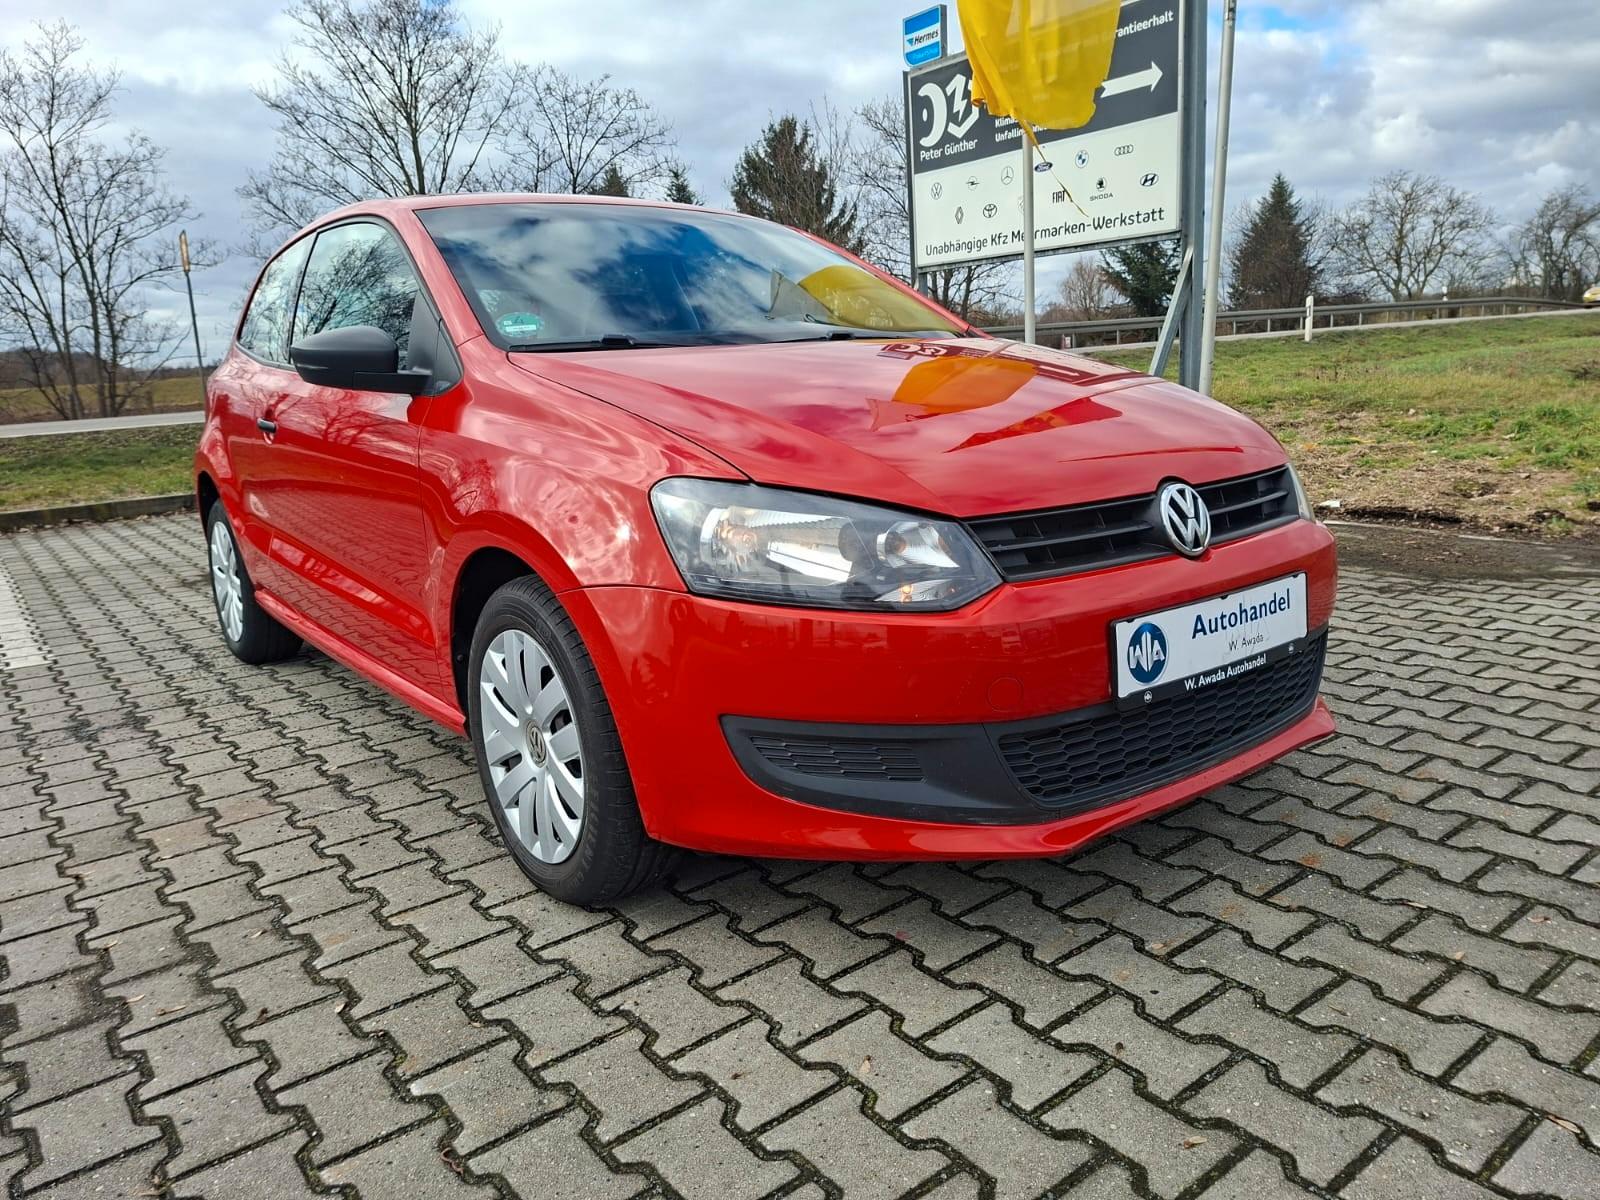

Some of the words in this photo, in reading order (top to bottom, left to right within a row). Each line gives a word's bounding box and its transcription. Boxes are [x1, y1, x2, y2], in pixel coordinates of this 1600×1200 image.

[914, 29, 939, 45] Hermes
[920, 148, 943, 162] Peter
[945, 139, 978, 155] Günther
[1053, 190, 1067, 204] FIAT
[926, 237, 988, 257] Unabhängige
[990, 232, 1008, 246] Kfz
[1011, 207, 1165, 244] Mermarken-Werkstatt
[1192, 587, 1290, 639] Autohandel
[1241, 633, 1264, 648] Awada
[1184, 678, 1197, 691] W.
[1198, 670, 1226, 687] Awada
[1226, 653, 1267, 678] Autohandel
